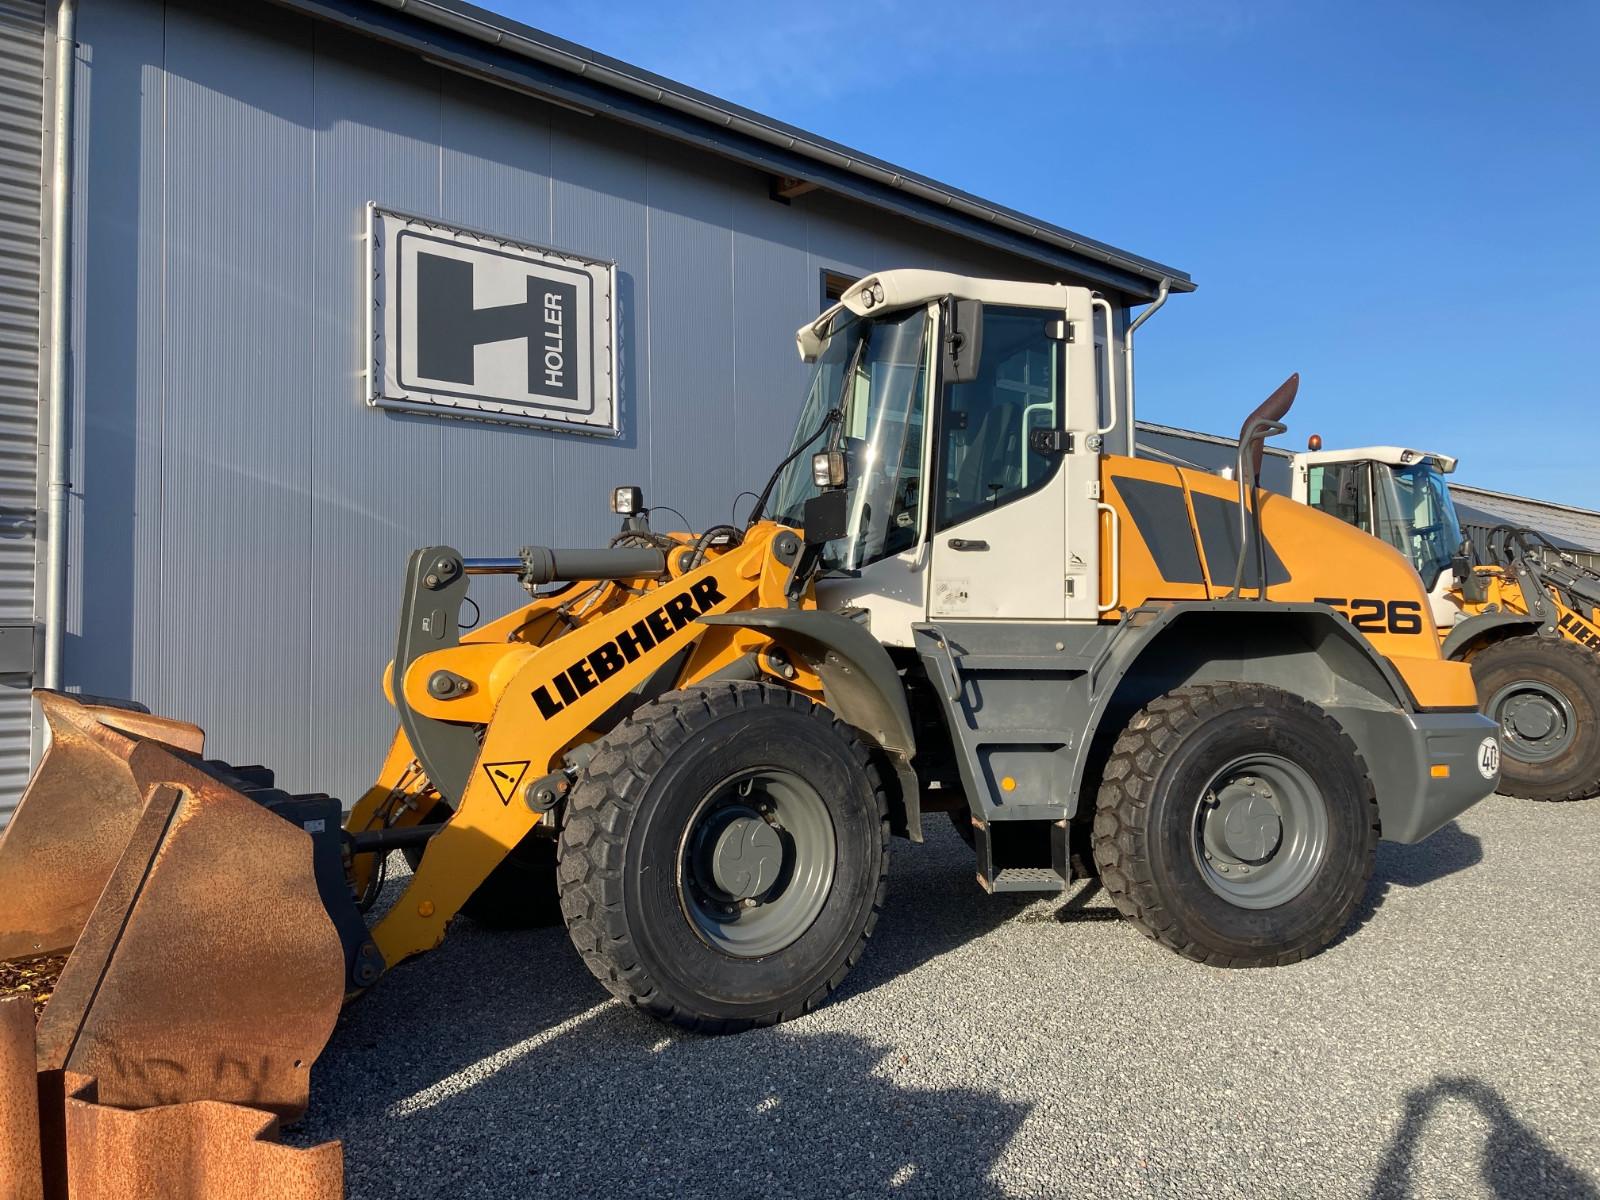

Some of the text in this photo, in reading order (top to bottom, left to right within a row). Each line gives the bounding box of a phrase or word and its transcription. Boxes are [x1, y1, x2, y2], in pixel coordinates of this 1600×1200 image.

[544, 292, 564, 387] HOLLER
[531, 575, 728, 721] LIEBHERR
[1482, 745, 1497, 771] 40
